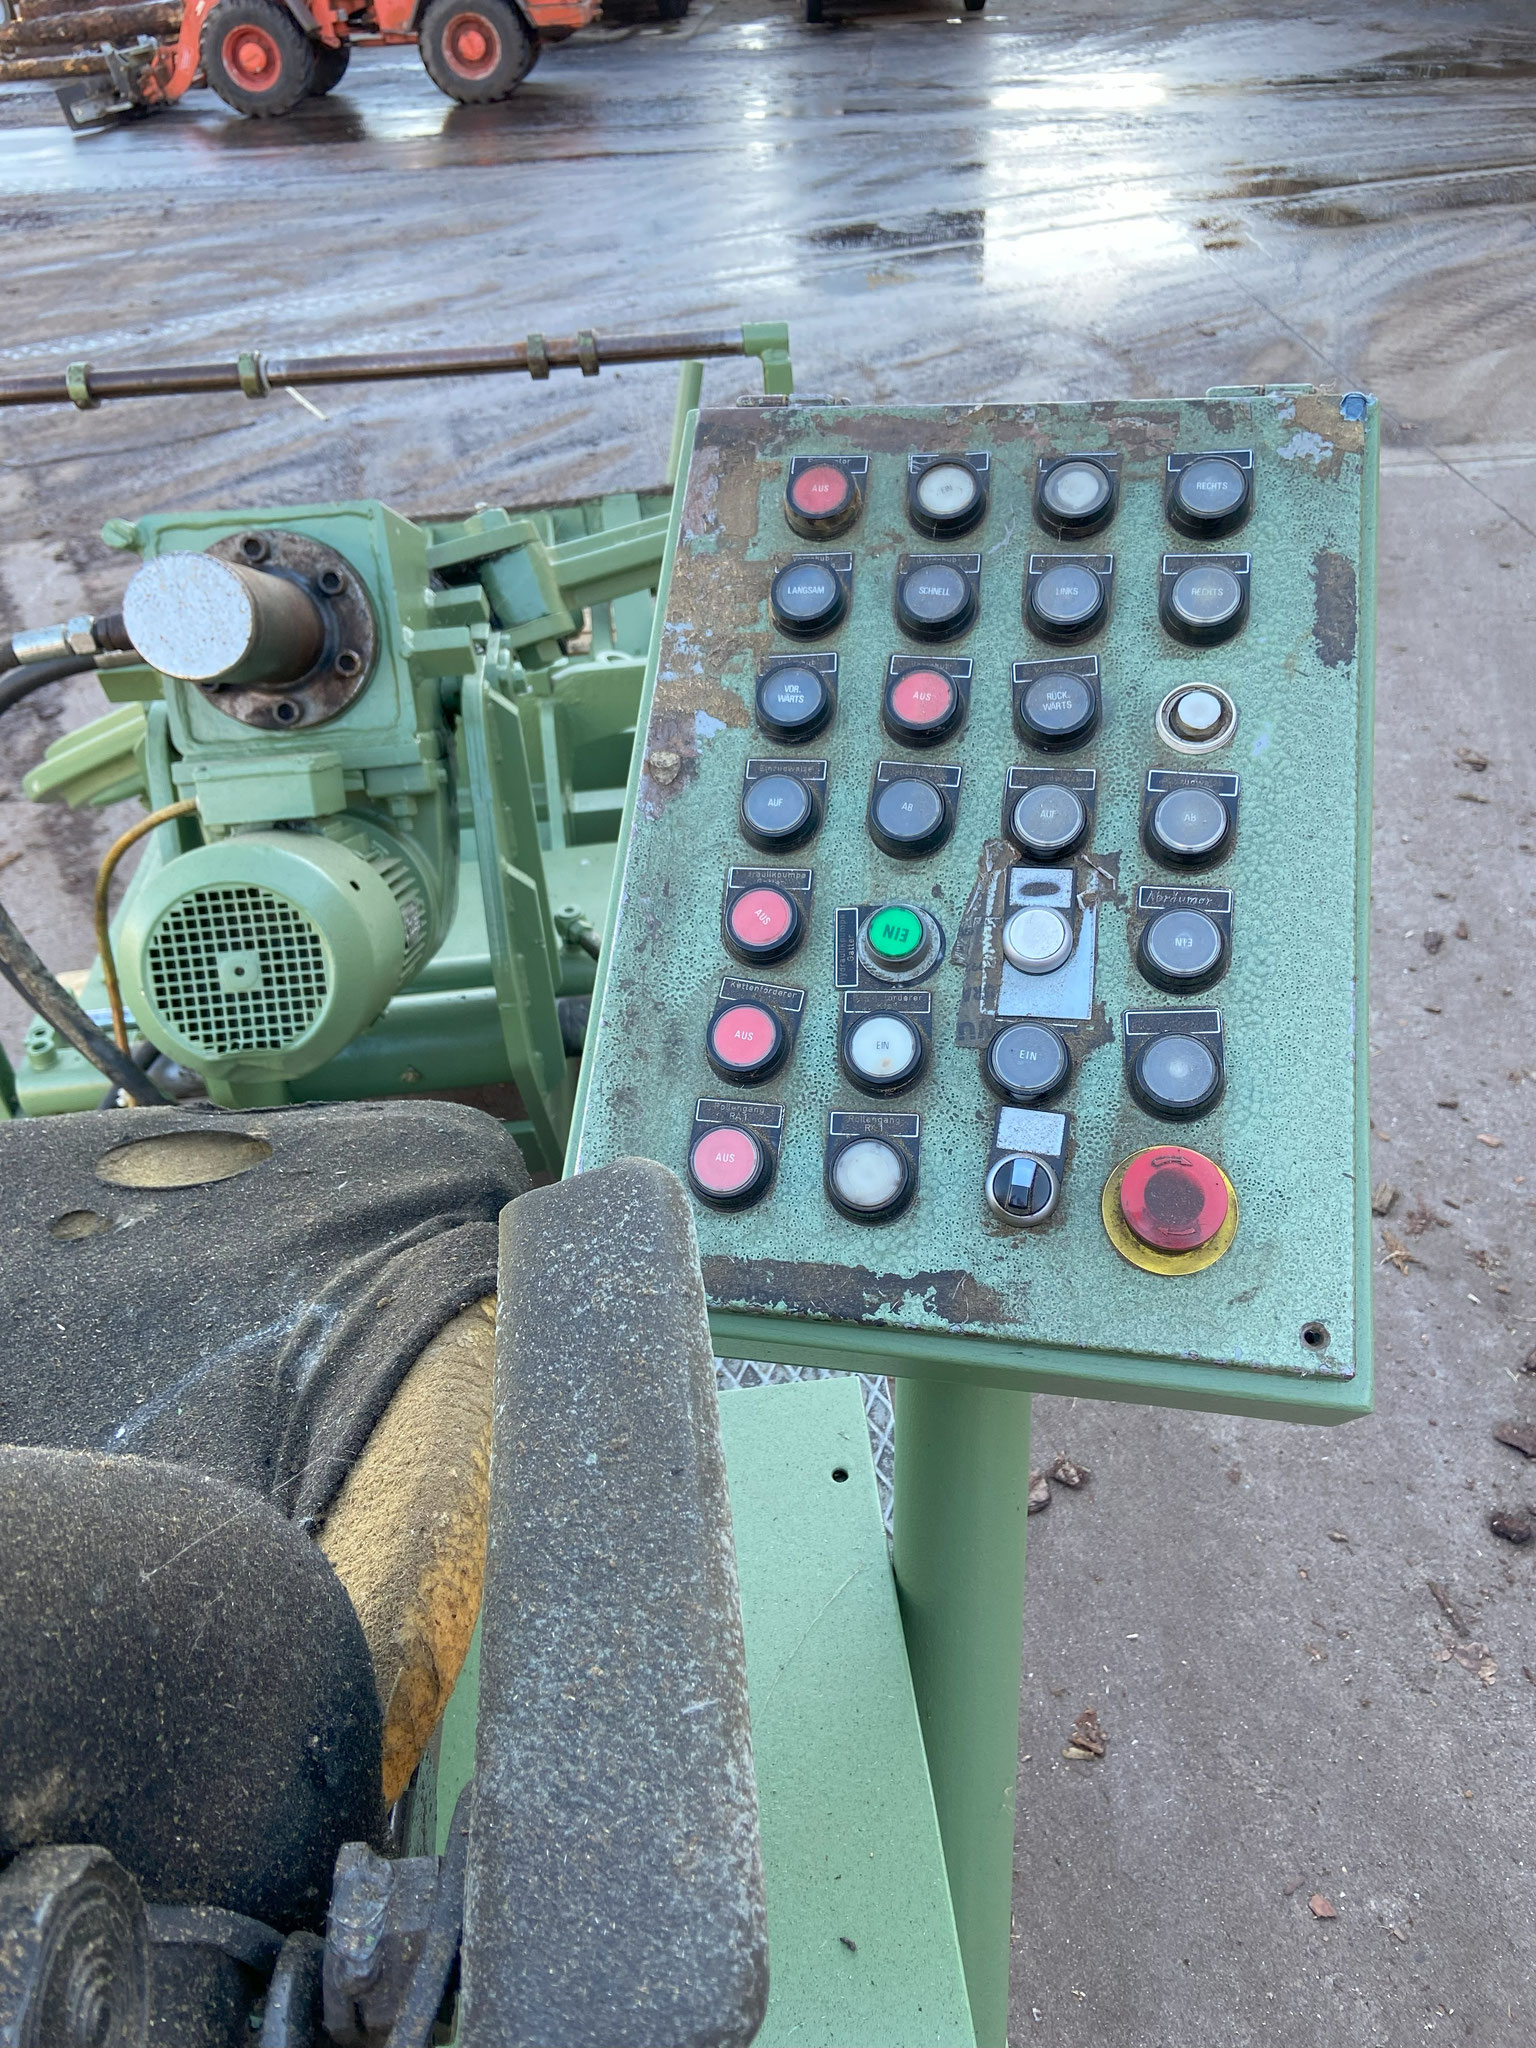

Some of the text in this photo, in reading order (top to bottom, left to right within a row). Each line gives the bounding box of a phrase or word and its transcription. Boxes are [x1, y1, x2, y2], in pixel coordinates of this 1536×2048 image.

[811, 484, 830, 493] AUS
[1196, 482, 1228, 490] RECHTS
[787, 586, 825, 595] LANGSAM
[919, 586, 950, 596] SCHNELL
[1055, 587, 1079, 596] LINKS
[1191, 587, 1224, 597] RECHTS
[777, 693, 805, 704] WÄRTS
[912, 691, 932, 701] AUS
[1043, 700, 1073, 711] WÄRTS
[768, 798, 783, 807] AUF
[901, 802, 913, 812] AB
[1040, 809, 1057, 818] AUF
[1183, 813, 1197, 822] AB
[754, 908, 772, 926] AUS
[882, 923, 909, 943] EIN
[1175, 937, 1193, 947] EIN
[734, 1029, 754, 1041] AUS
[876, 1041, 889, 1050] EIN
[1019, 1049, 1037, 1061] EIN
[715, 1153, 735, 1163] AUS
